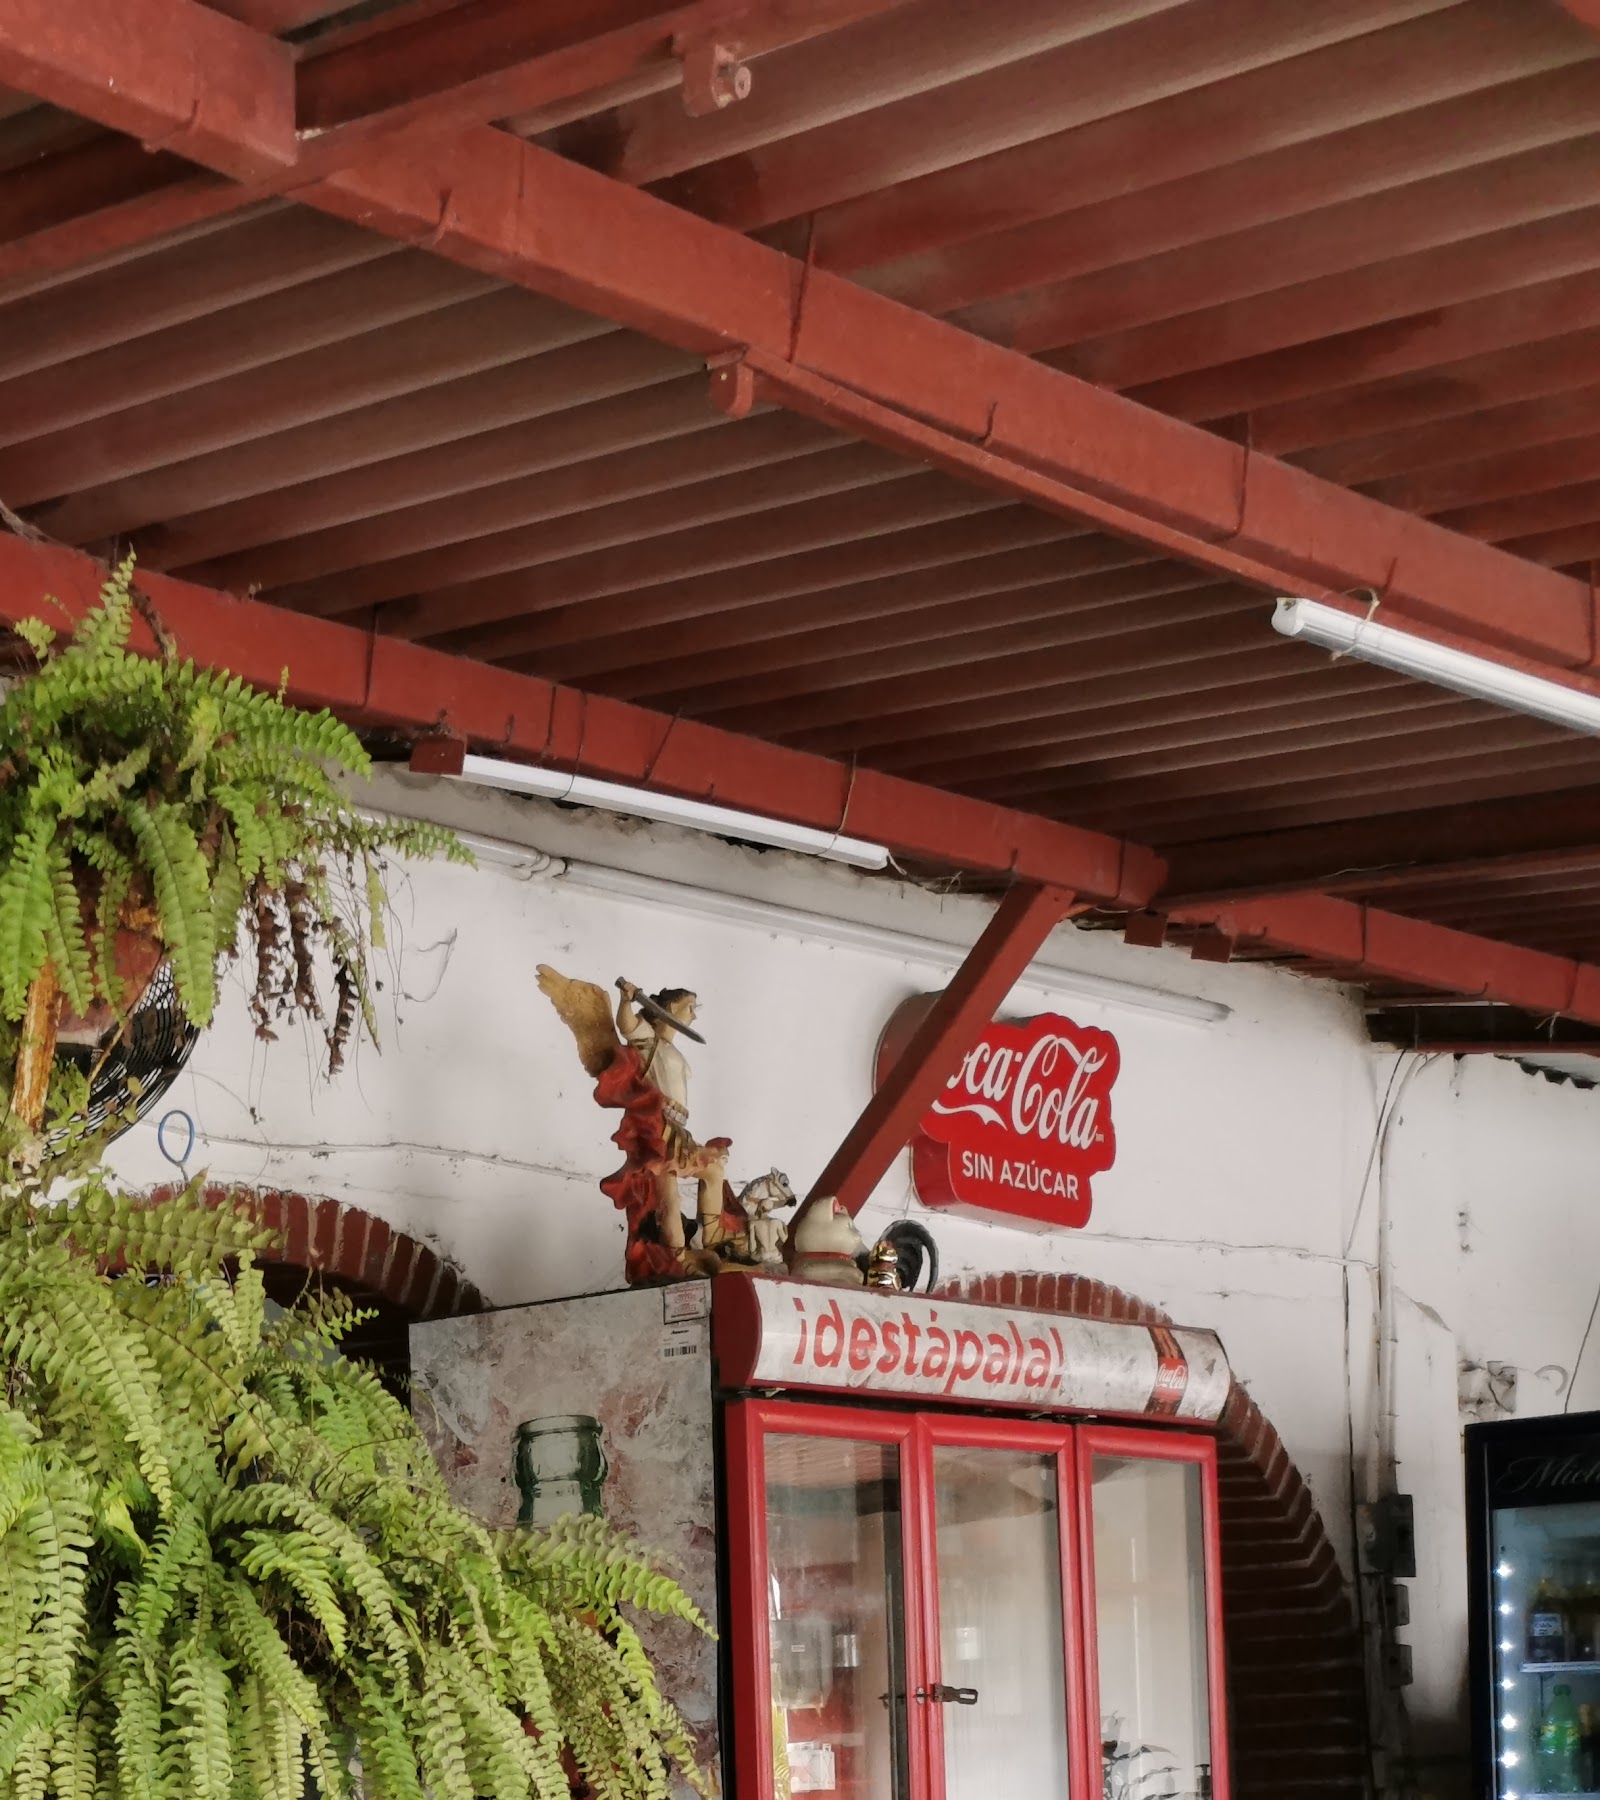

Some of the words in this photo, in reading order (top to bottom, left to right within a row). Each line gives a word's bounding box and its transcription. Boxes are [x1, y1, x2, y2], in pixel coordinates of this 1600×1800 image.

[962, 1150, 993, 1181] SIN
[999, 1160, 1080, 1200] AZÚCAR
[792, 1297, 1065, 1394] ¡destápala!
